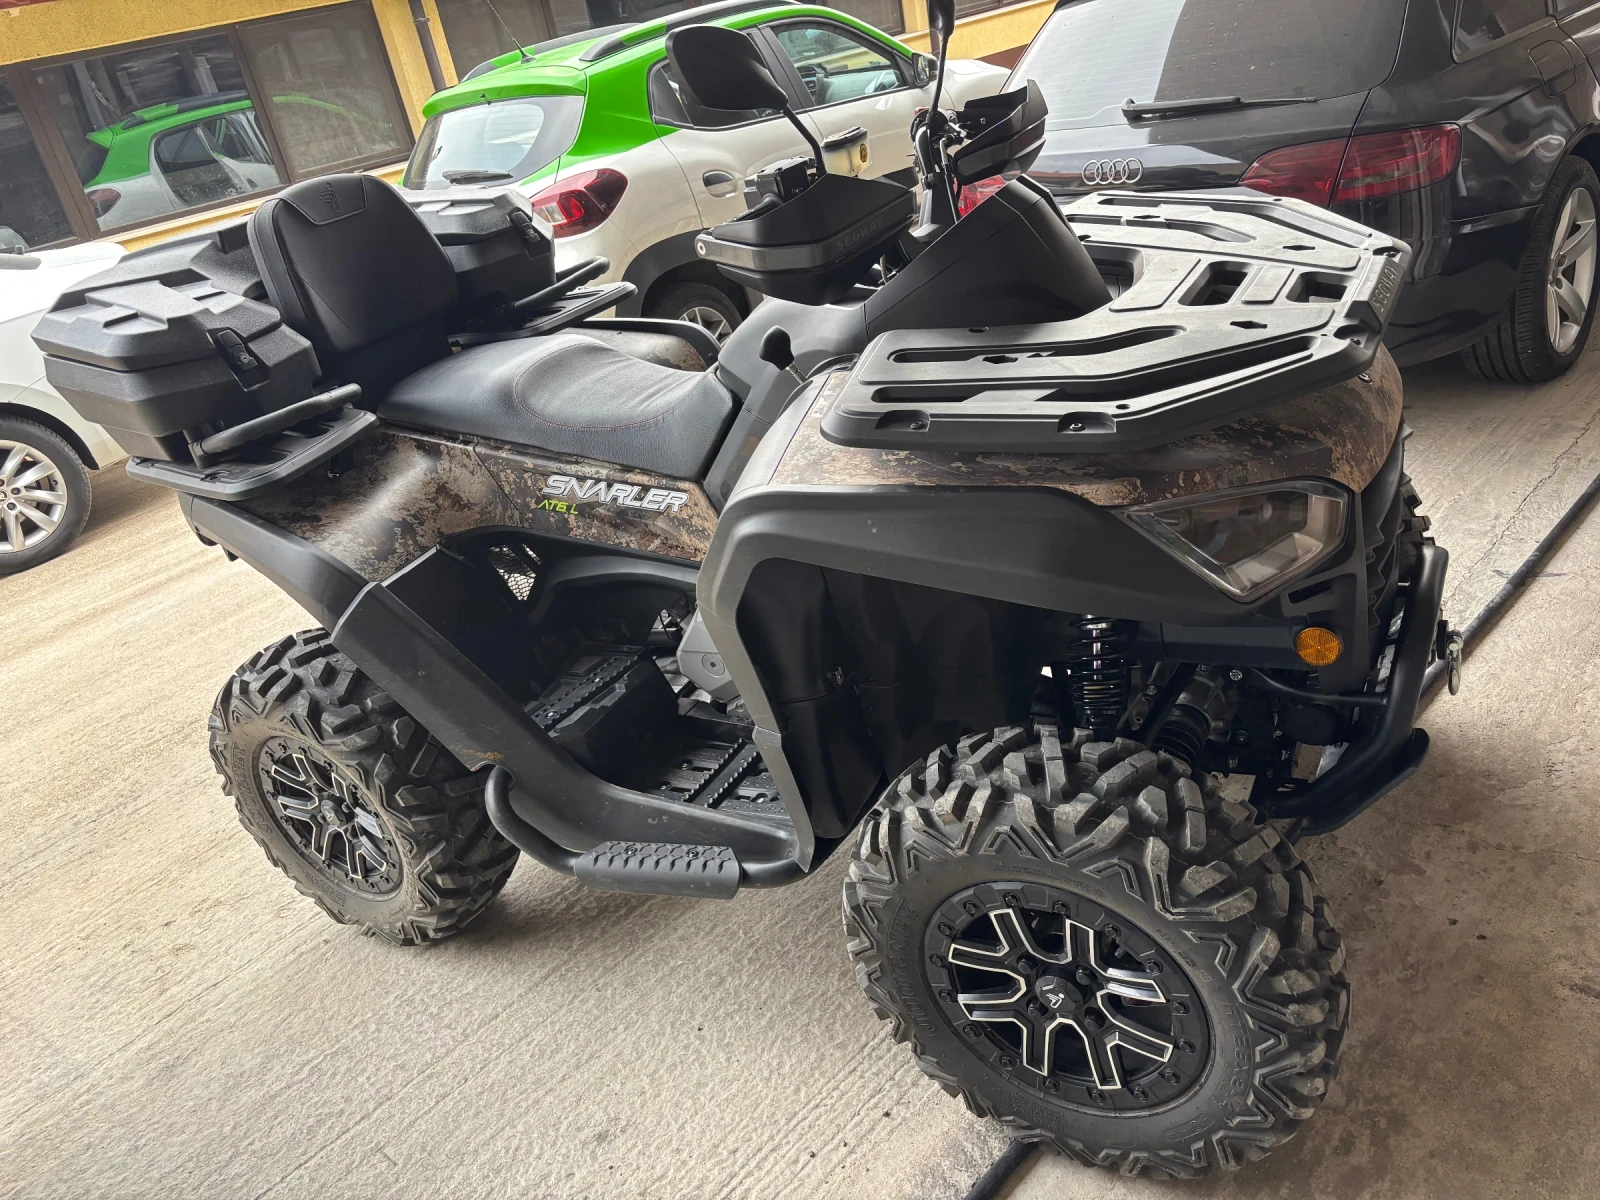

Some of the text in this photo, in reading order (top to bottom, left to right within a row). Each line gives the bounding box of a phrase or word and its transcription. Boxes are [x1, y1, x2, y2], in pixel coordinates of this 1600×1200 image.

[835, 215, 884, 252] SEGWAY
[1373, 262, 1399, 312] SEGWAY
[537, 500, 579, 514] AT6 L
[542, 474, 689, 513] SNARLER
[889, 897, 937, 1037] JOURNEY
